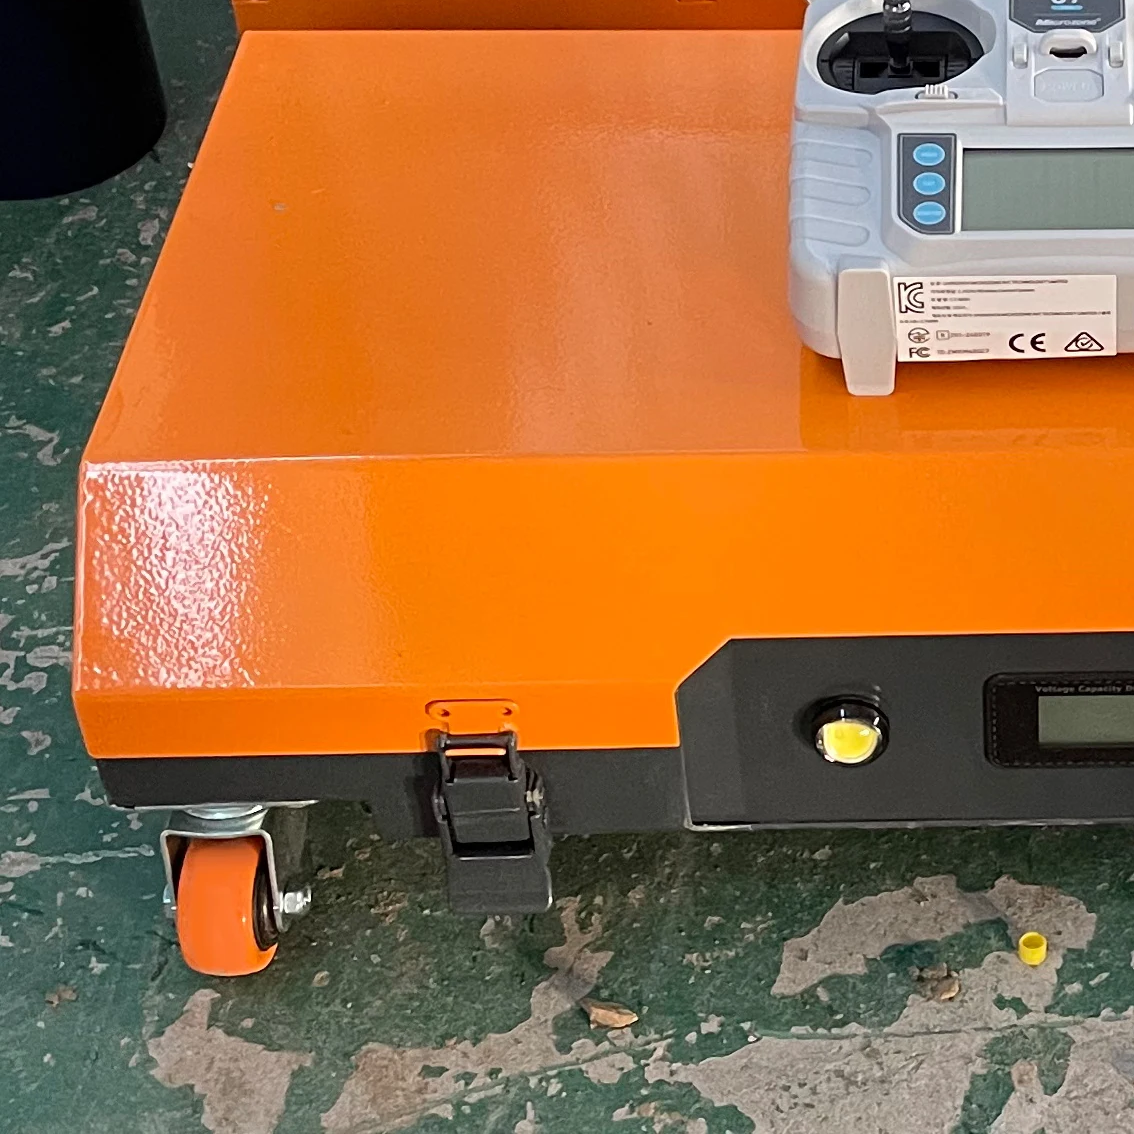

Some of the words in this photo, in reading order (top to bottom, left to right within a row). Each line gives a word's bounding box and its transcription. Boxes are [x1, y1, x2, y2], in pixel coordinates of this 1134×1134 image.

[1008, 332, 1047, 353] CE
[1035, 685, 1075, 694] Voltage
[1078, 685, 1122, 694] Capacity
